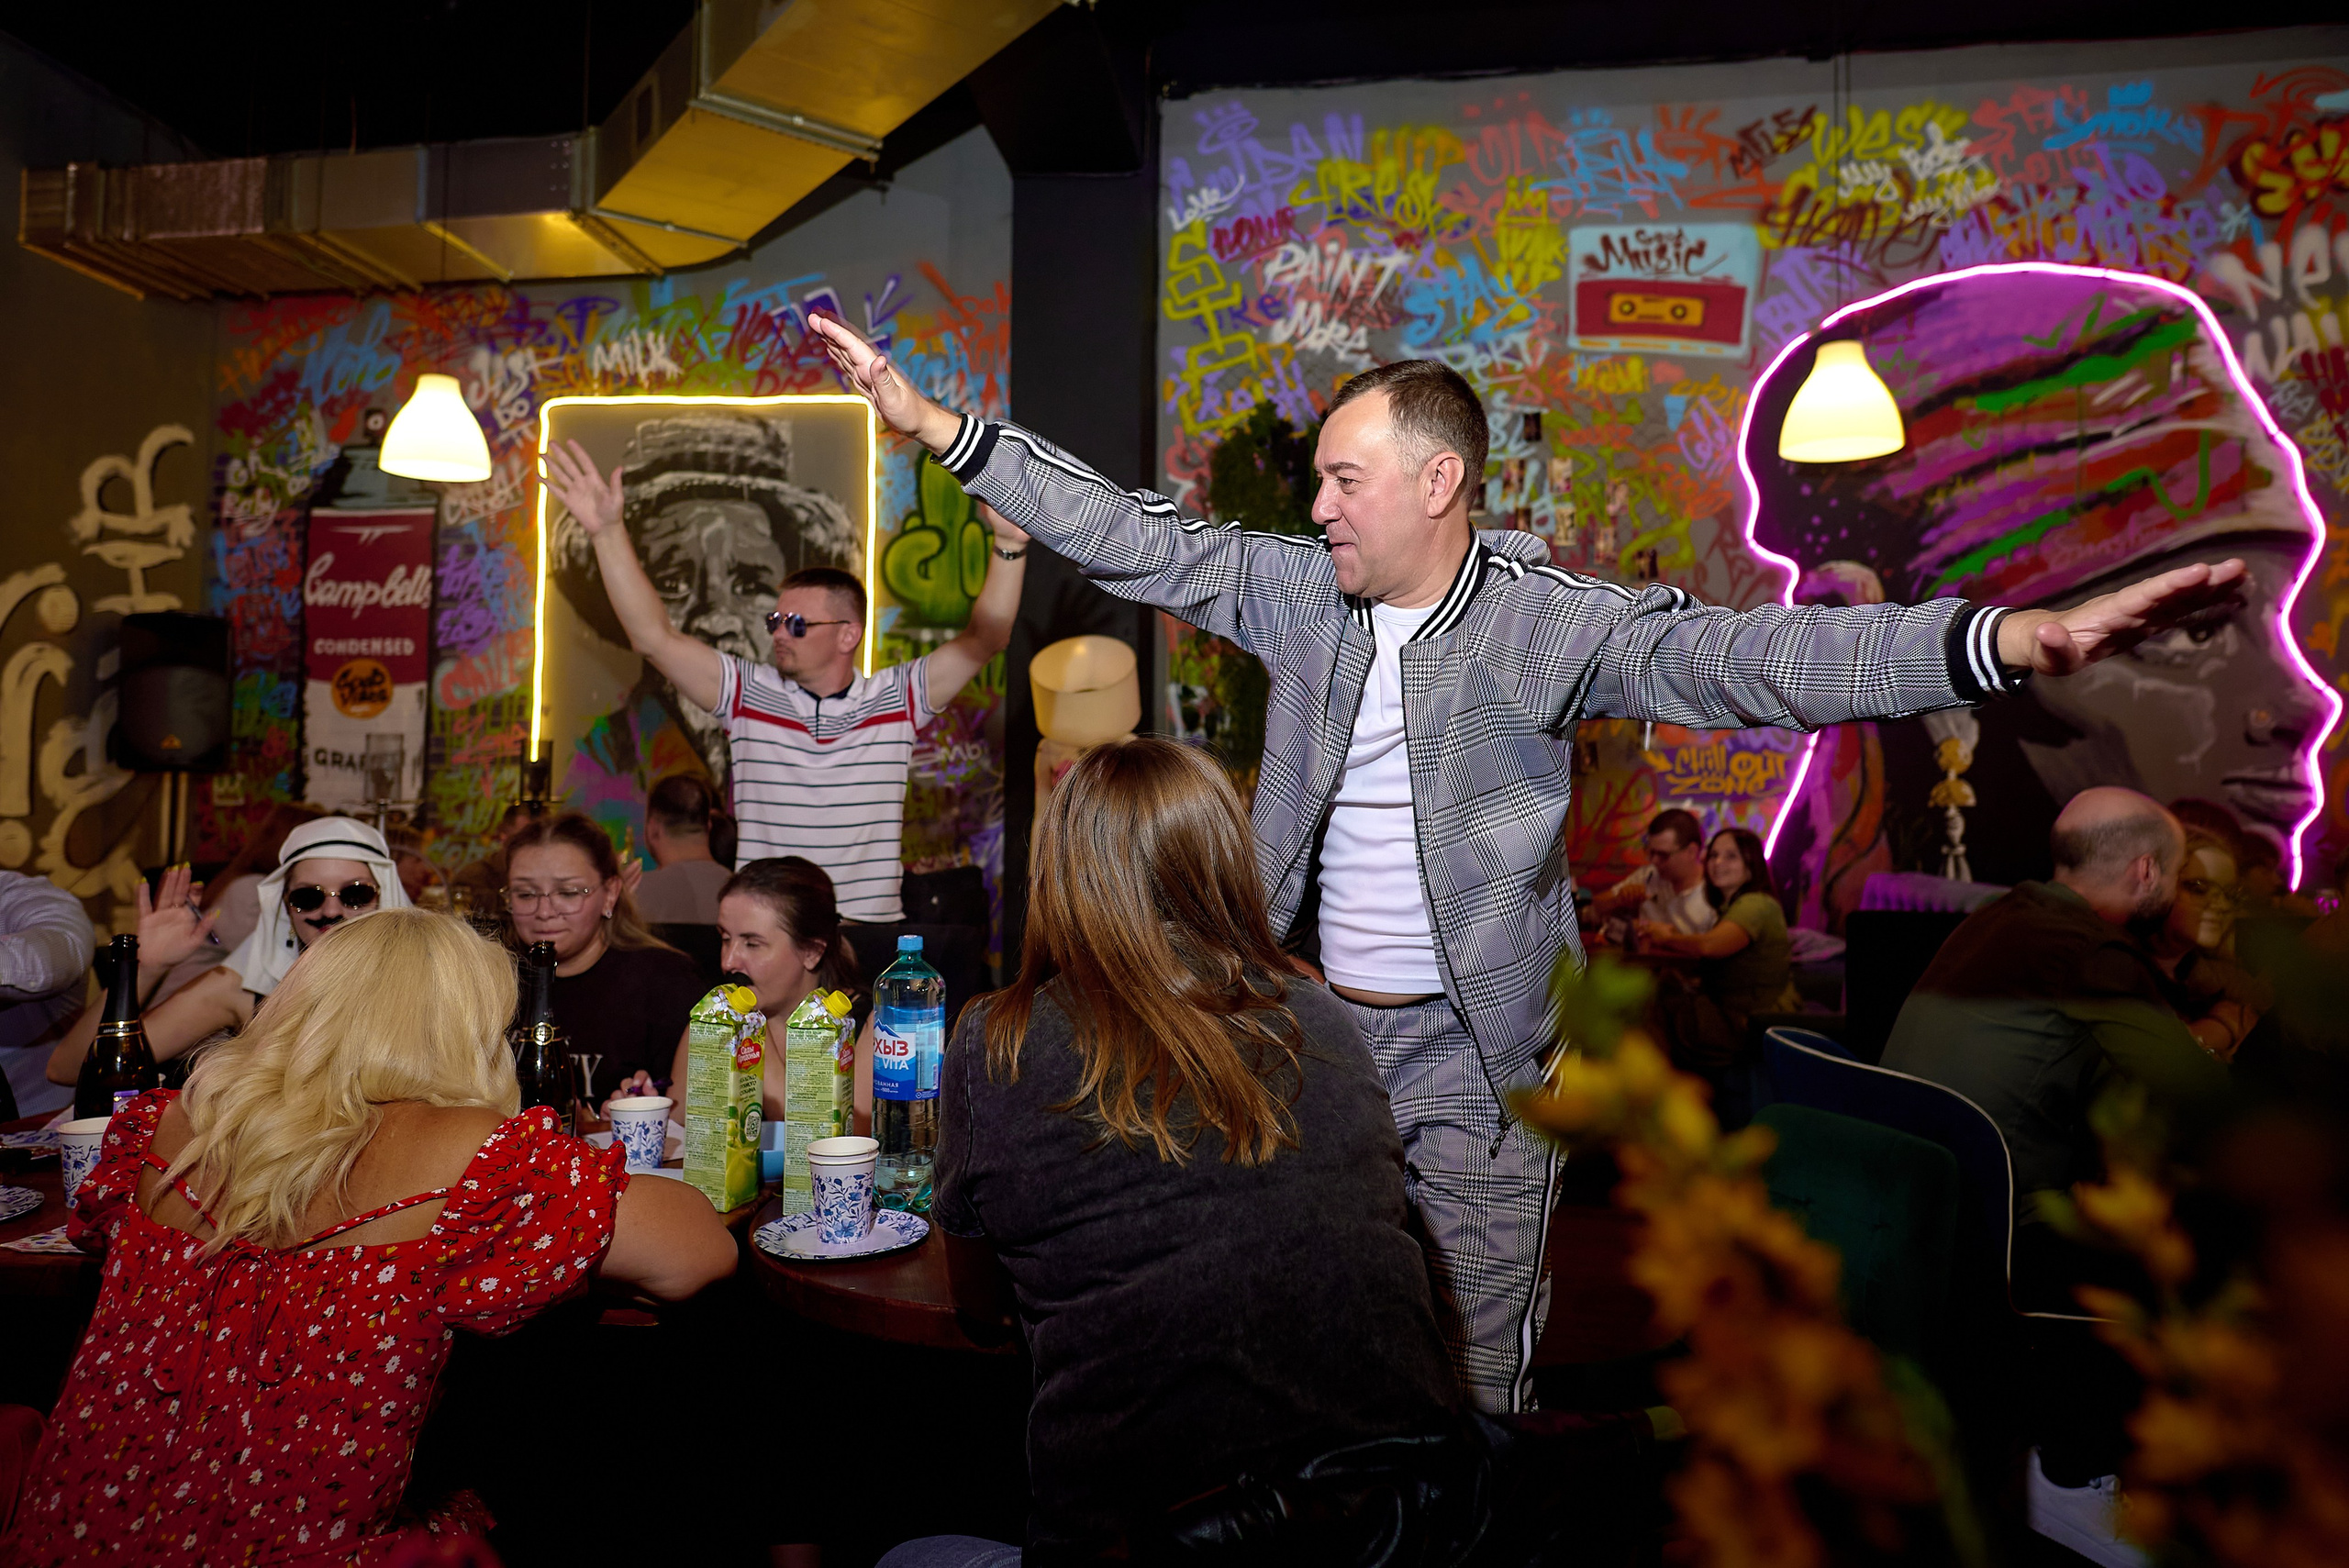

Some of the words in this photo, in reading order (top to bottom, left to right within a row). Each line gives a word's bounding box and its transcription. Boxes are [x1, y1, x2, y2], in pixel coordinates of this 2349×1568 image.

[313, 638, 415, 656] CONDENSED
[1730, 749, 1787, 780] OUT
[874, 1038, 909, 1056] ХЫЗ
[882, 1058, 909, 1070] VITA
